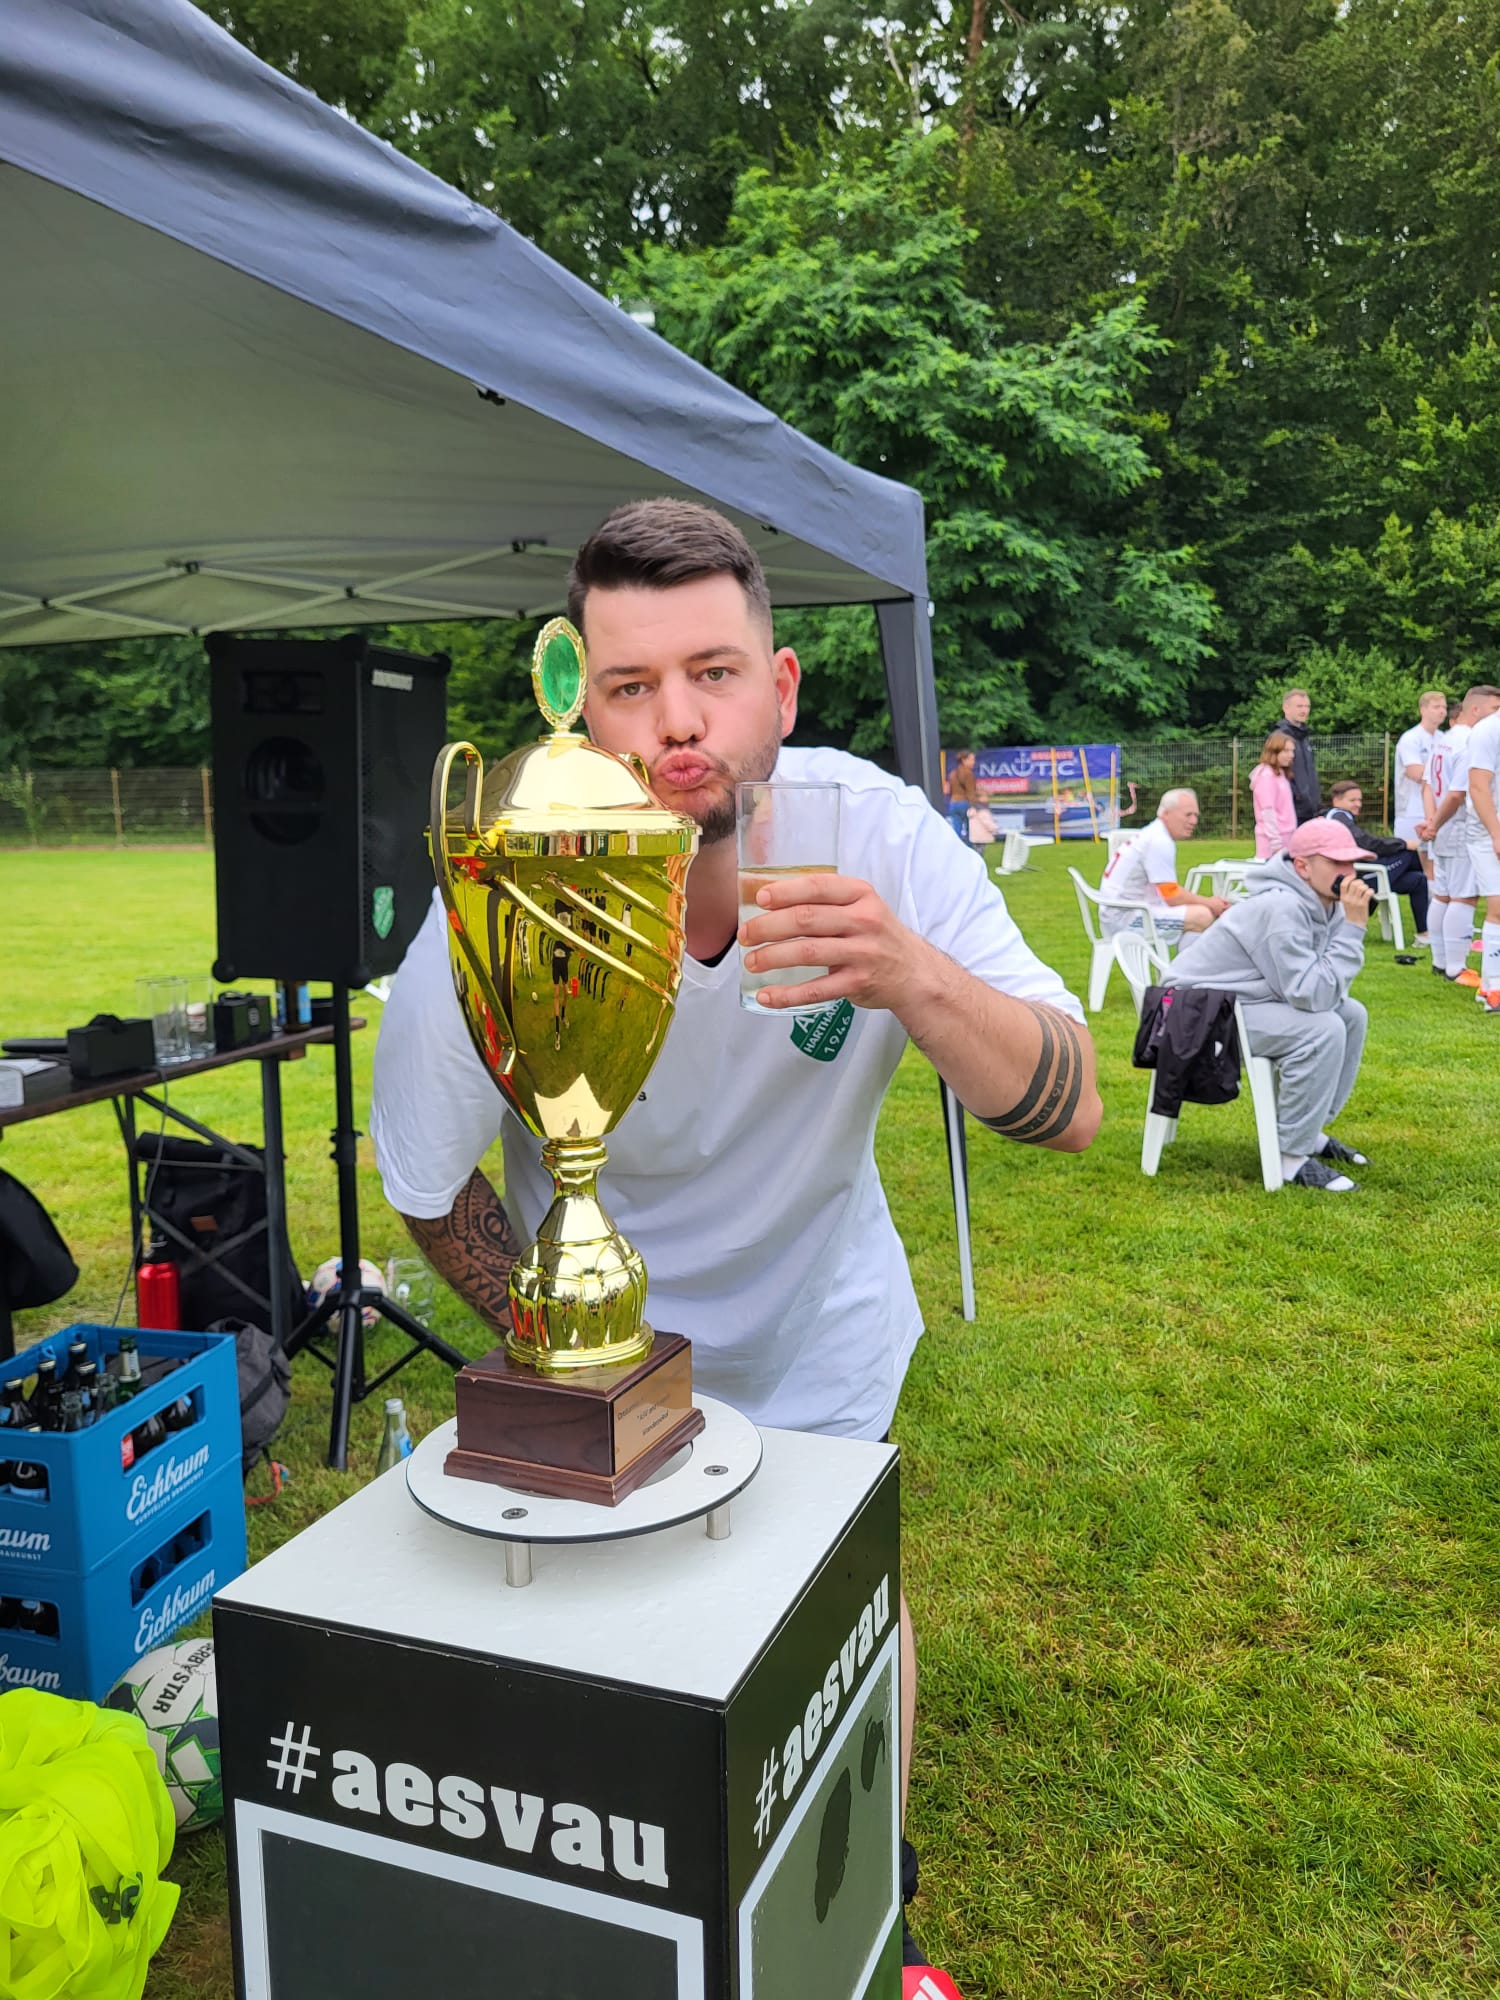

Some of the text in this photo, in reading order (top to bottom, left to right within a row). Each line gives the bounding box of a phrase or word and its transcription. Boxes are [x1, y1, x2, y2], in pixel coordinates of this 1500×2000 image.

[803, 997, 845, 1053] HARTHAUS
[824, 1016, 851, 1054] 1946
[126, 1444, 209, 1520] Eichbaum
[0, 1528, 51, 1551] aum
[134, 1568, 215, 1654] Eichbaum
[0, 1653, 61, 1689] baum
[152, 1642, 215, 1714] ERBYSTAR
[753, 1573, 890, 1849] #aesvau
[267, 1721, 669, 1889] #aesvau
